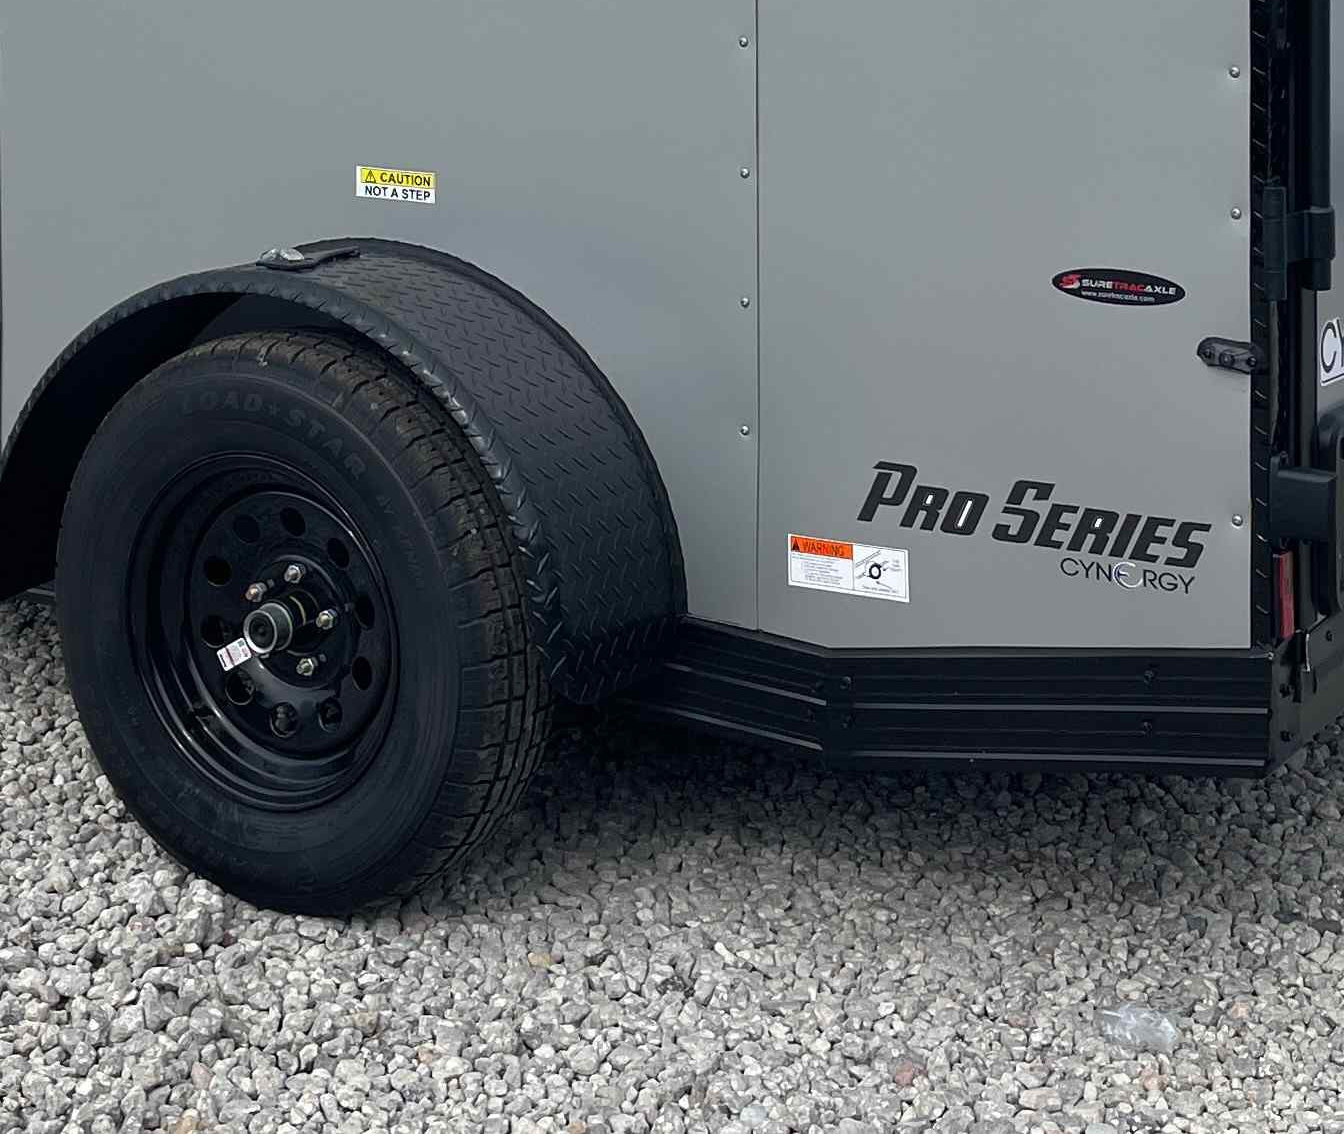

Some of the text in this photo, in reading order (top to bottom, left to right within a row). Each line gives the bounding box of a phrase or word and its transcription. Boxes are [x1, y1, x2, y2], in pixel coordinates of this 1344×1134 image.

[379, 172, 431, 187] CAUTION
[365, 185, 431, 201] NOT A STEP
[1081, 277, 1177, 296] SURETRACAXLE
[802, 540, 846, 558] WARNING
[1059, 557, 1197, 595] CYNERGY
